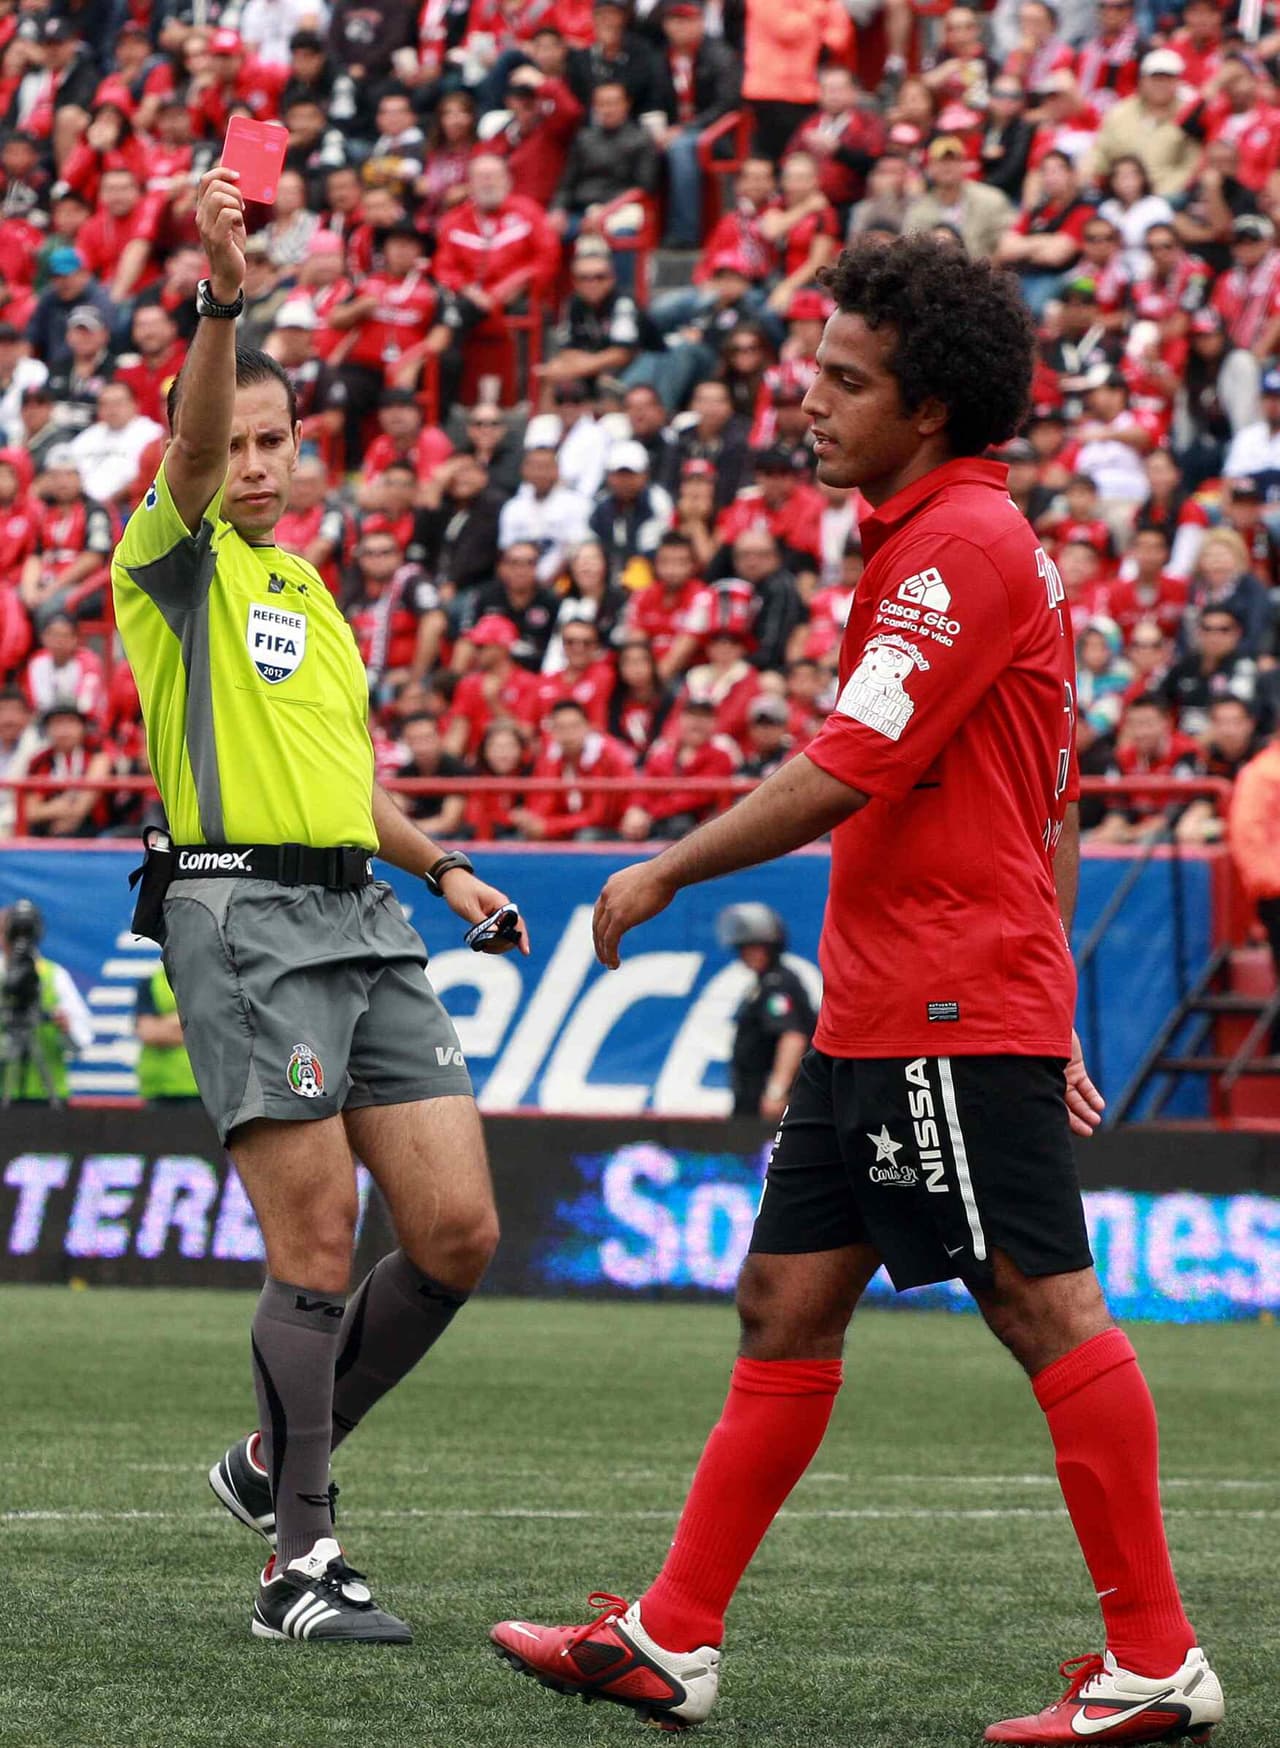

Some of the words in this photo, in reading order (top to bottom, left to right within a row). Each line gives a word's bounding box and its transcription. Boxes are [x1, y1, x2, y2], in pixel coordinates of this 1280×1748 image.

[253, 609, 302, 629] REFEREE
[880, 599, 920, 620] Casas
[923, 611, 961, 635] GEO
[254, 632, 296, 656] FIFA
[931, 631, 954, 647] vida
[263, 666, 283, 678] 2012
[179, 848, 254, 870] Comex
[905, 1057, 949, 1193] NISSA
